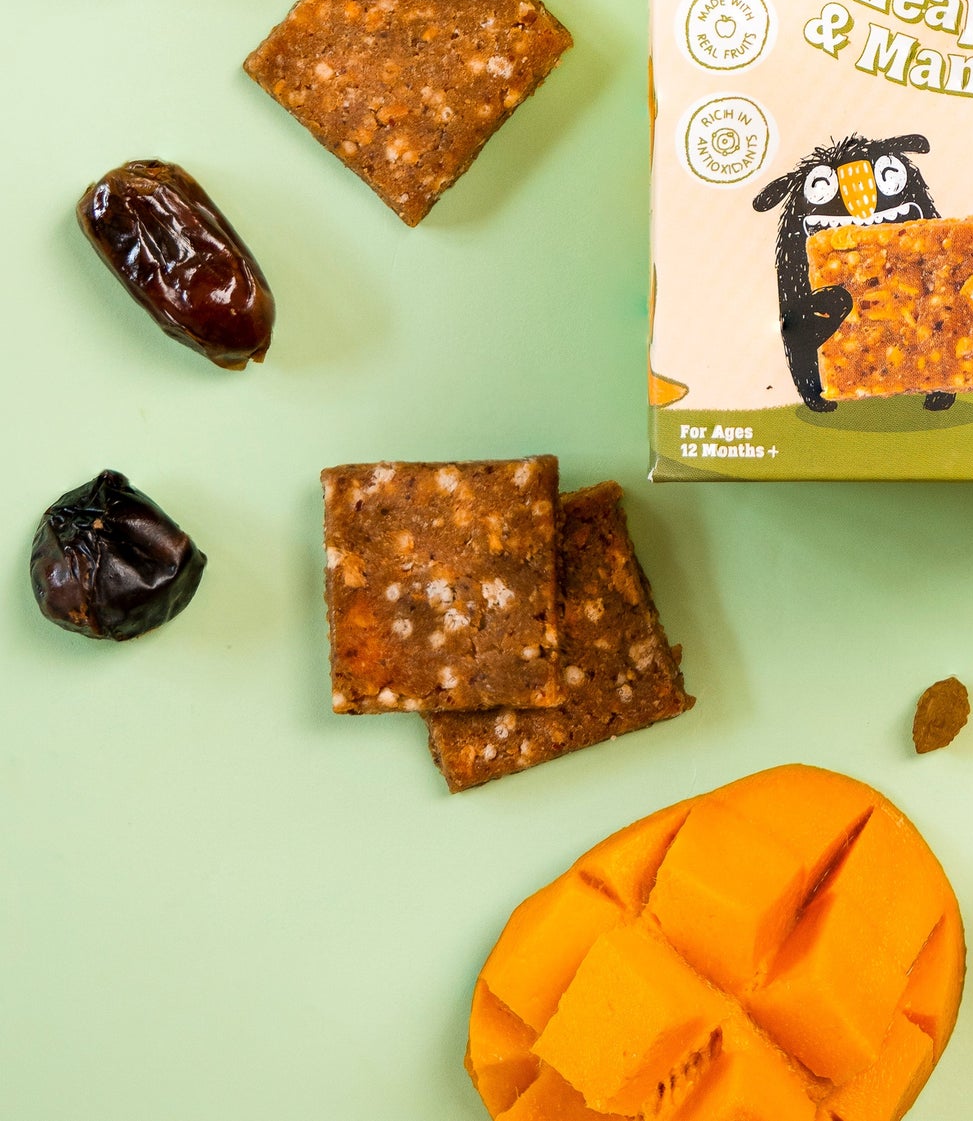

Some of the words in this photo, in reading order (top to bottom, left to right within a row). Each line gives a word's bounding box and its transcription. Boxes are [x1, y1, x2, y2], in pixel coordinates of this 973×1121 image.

[803, 2, 855, 59] &
[697, 33, 718, 59] REAL
[724, 32, 757, 59] FRUITS
[701, 109, 734, 127] RICH
[737, 112, 752, 125] IN
[697, 134, 758, 174] ANTIOXIDANTS
[680, 424, 707, 439] For
[711, 424, 753, 442] Ages
[681, 443, 698, 457] 12
